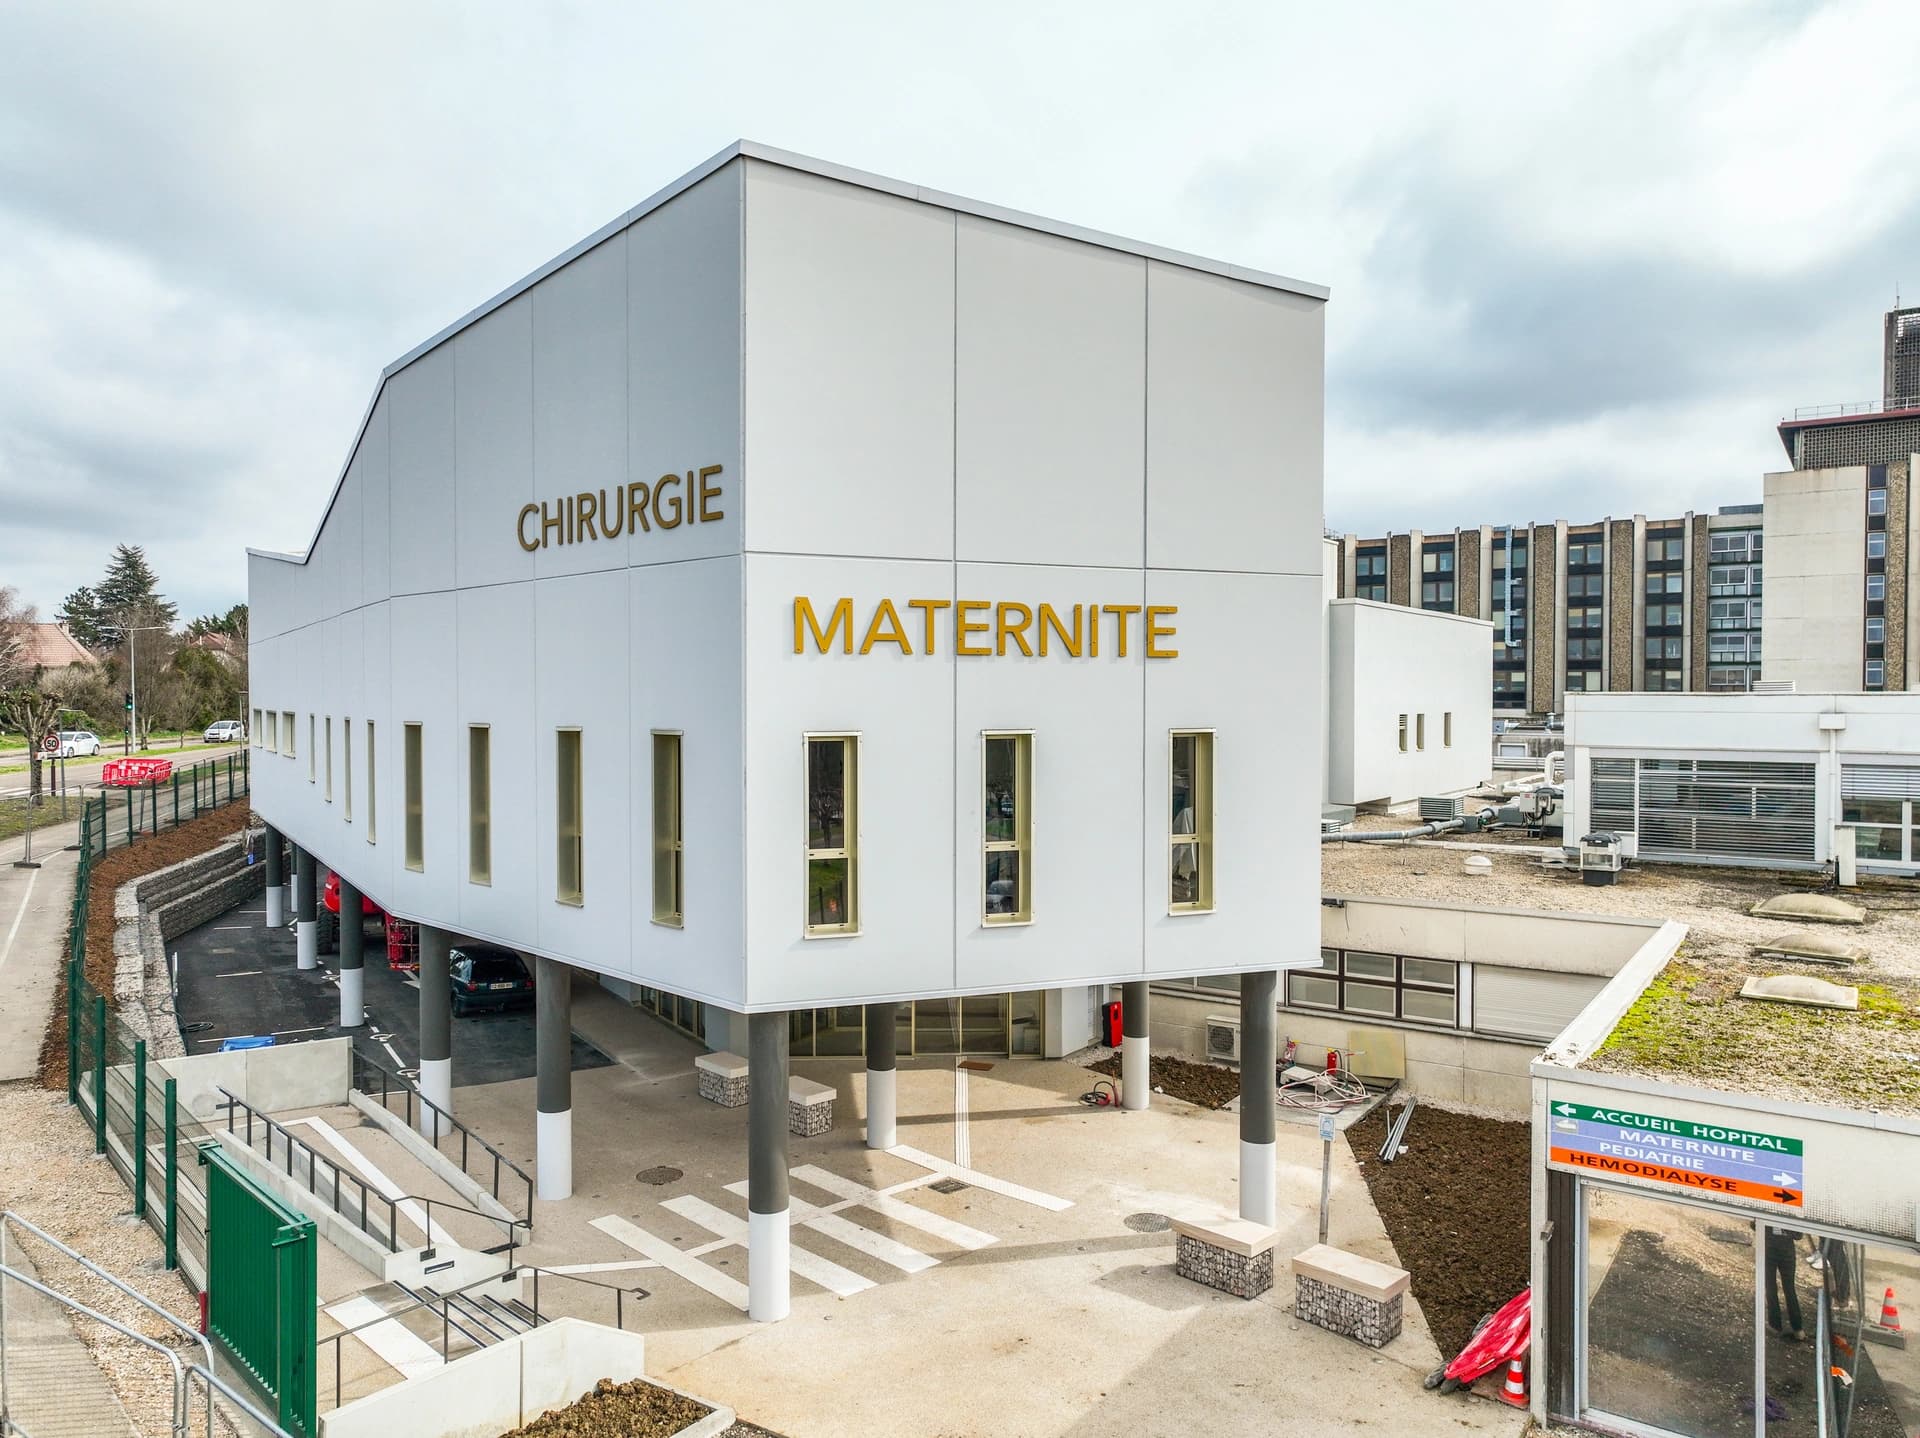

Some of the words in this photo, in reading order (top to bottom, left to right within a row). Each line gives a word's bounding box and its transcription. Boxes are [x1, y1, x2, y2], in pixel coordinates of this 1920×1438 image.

[517, 464, 724, 552] CHIRURGIE
[793, 596, 1179, 658] MATERNITE
[46, 739, 57, 748] 50
[1591, 1110, 1681, 1133] ACCUEIL
[1692, 1125, 1789, 1151] HOPITAL
[1619, 1129, 1755, 1163] MATERNITE
[1569, 1152, 1737, 1192] HEMODIALYSE
[1599, 1143, 1705, 1171] PEDIATRIE
